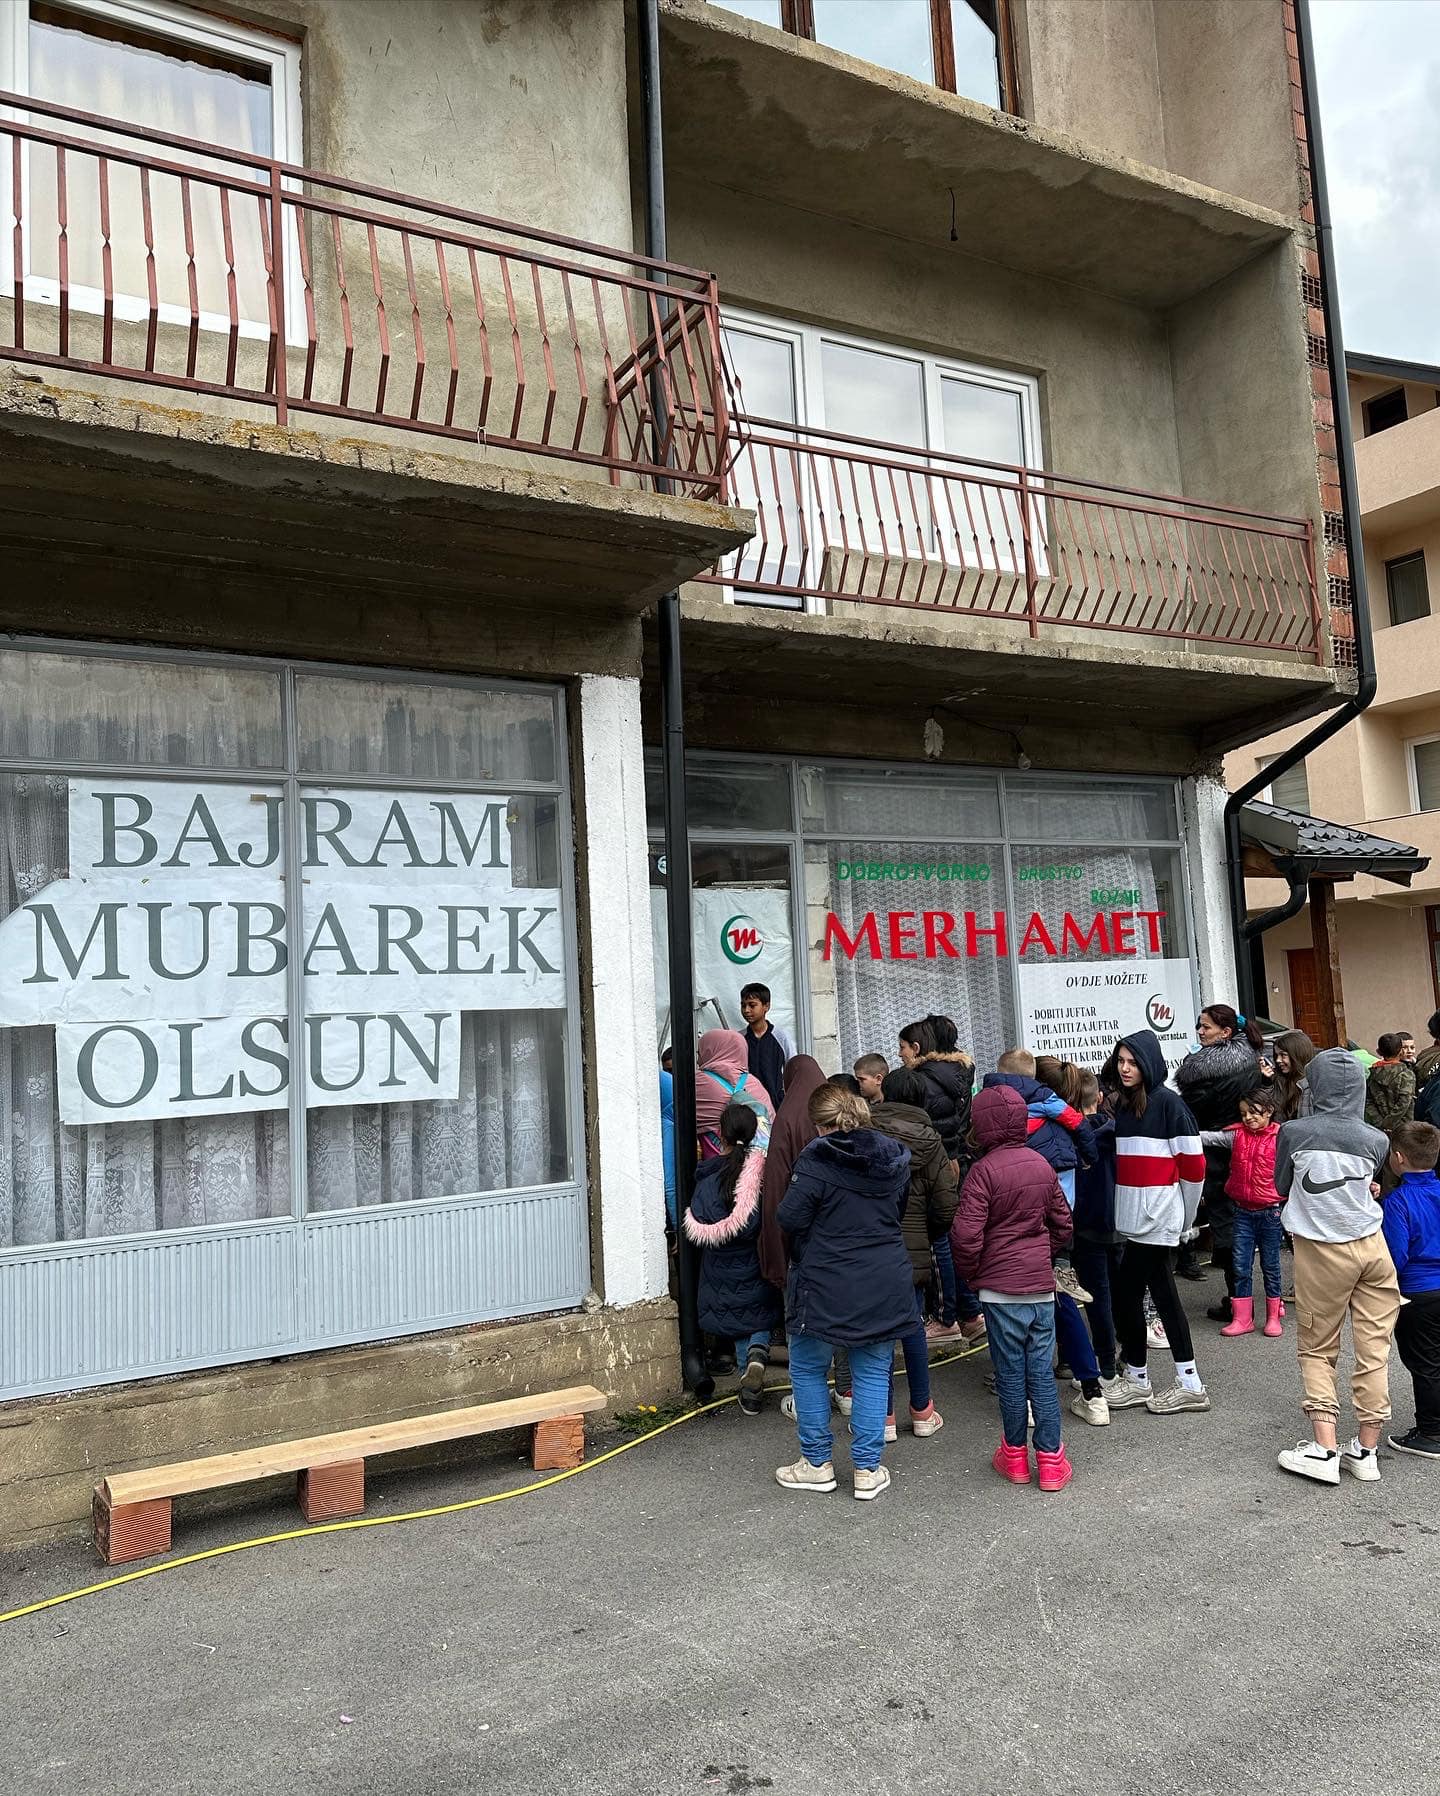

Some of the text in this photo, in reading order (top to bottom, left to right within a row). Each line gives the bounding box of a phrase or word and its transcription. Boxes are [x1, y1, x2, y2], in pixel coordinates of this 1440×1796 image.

[91, 792, 509, 870] BAJRAM
[836, 862, 1083, 883] DOBROTVORNO DRUŠTVO
[21, 902, 562, 985] MUBAREK
[823, 910, 1169, 962] MERHAMET
[1066, 971, 1149, 988] OVDJE MOŽETE
[1034, 1008, 1064, 1021] DOBITI
[1065, 1006, 1097, 1019] JUFTAR
[1035, 1022, 1075, 1035] UPLATITI
[1076, 1021, 1088, 1033] ZA
[1088, 1019, 1120, 1031] JUFTAR
[1037, 1037, 1076, 1051] UPLATITI
[1077, 1036, 1089, 1048] ZA
[76, 1012, 452, 1109] OLSUN
